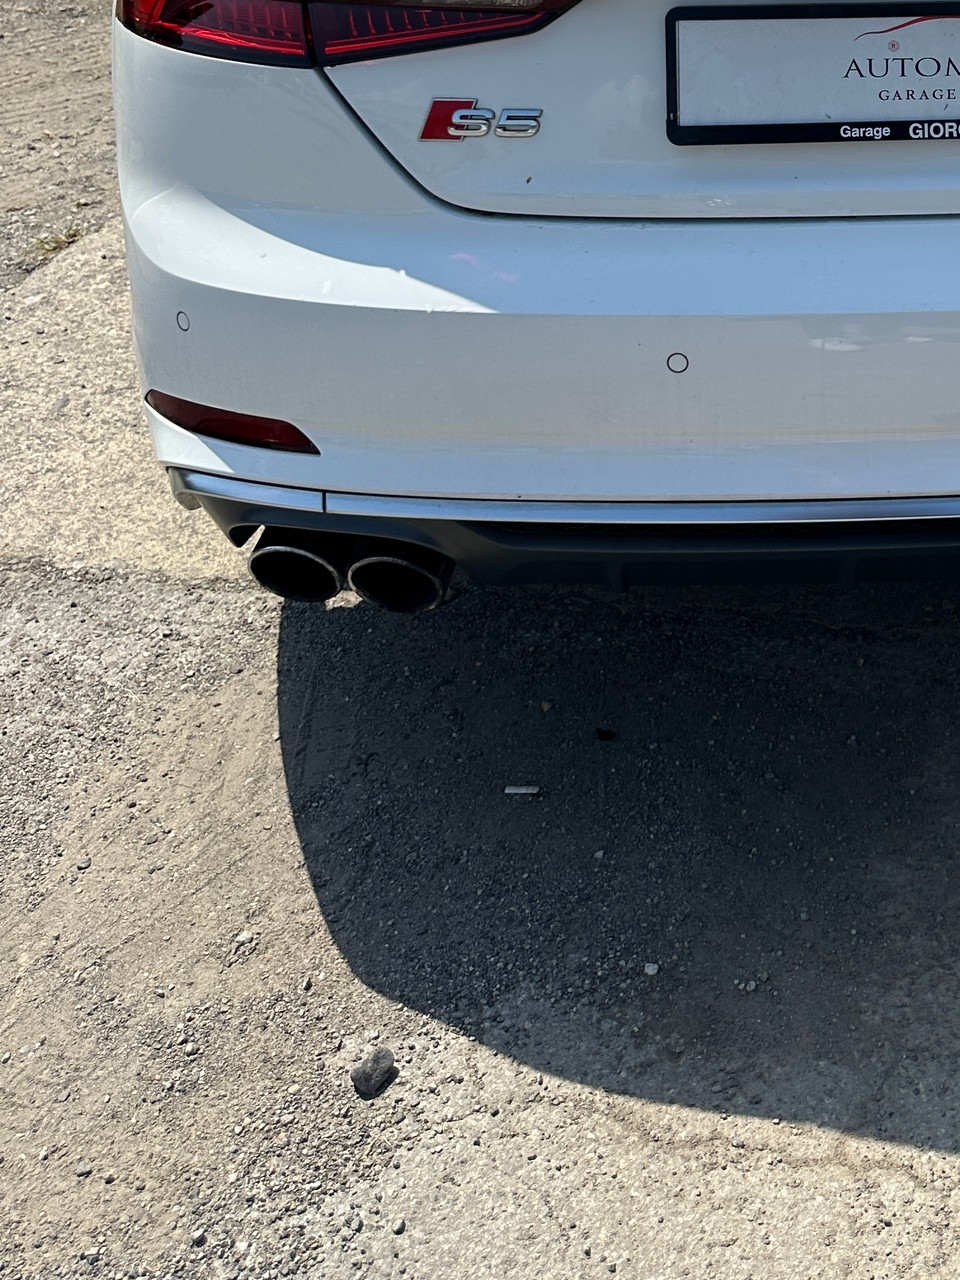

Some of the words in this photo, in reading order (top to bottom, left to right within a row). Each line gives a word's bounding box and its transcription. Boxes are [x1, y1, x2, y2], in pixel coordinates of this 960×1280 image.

[878, 88, 956, 102] GARAGE
[446, 107, 544, 139] S5
[839, 125, 891, 140] Garage
